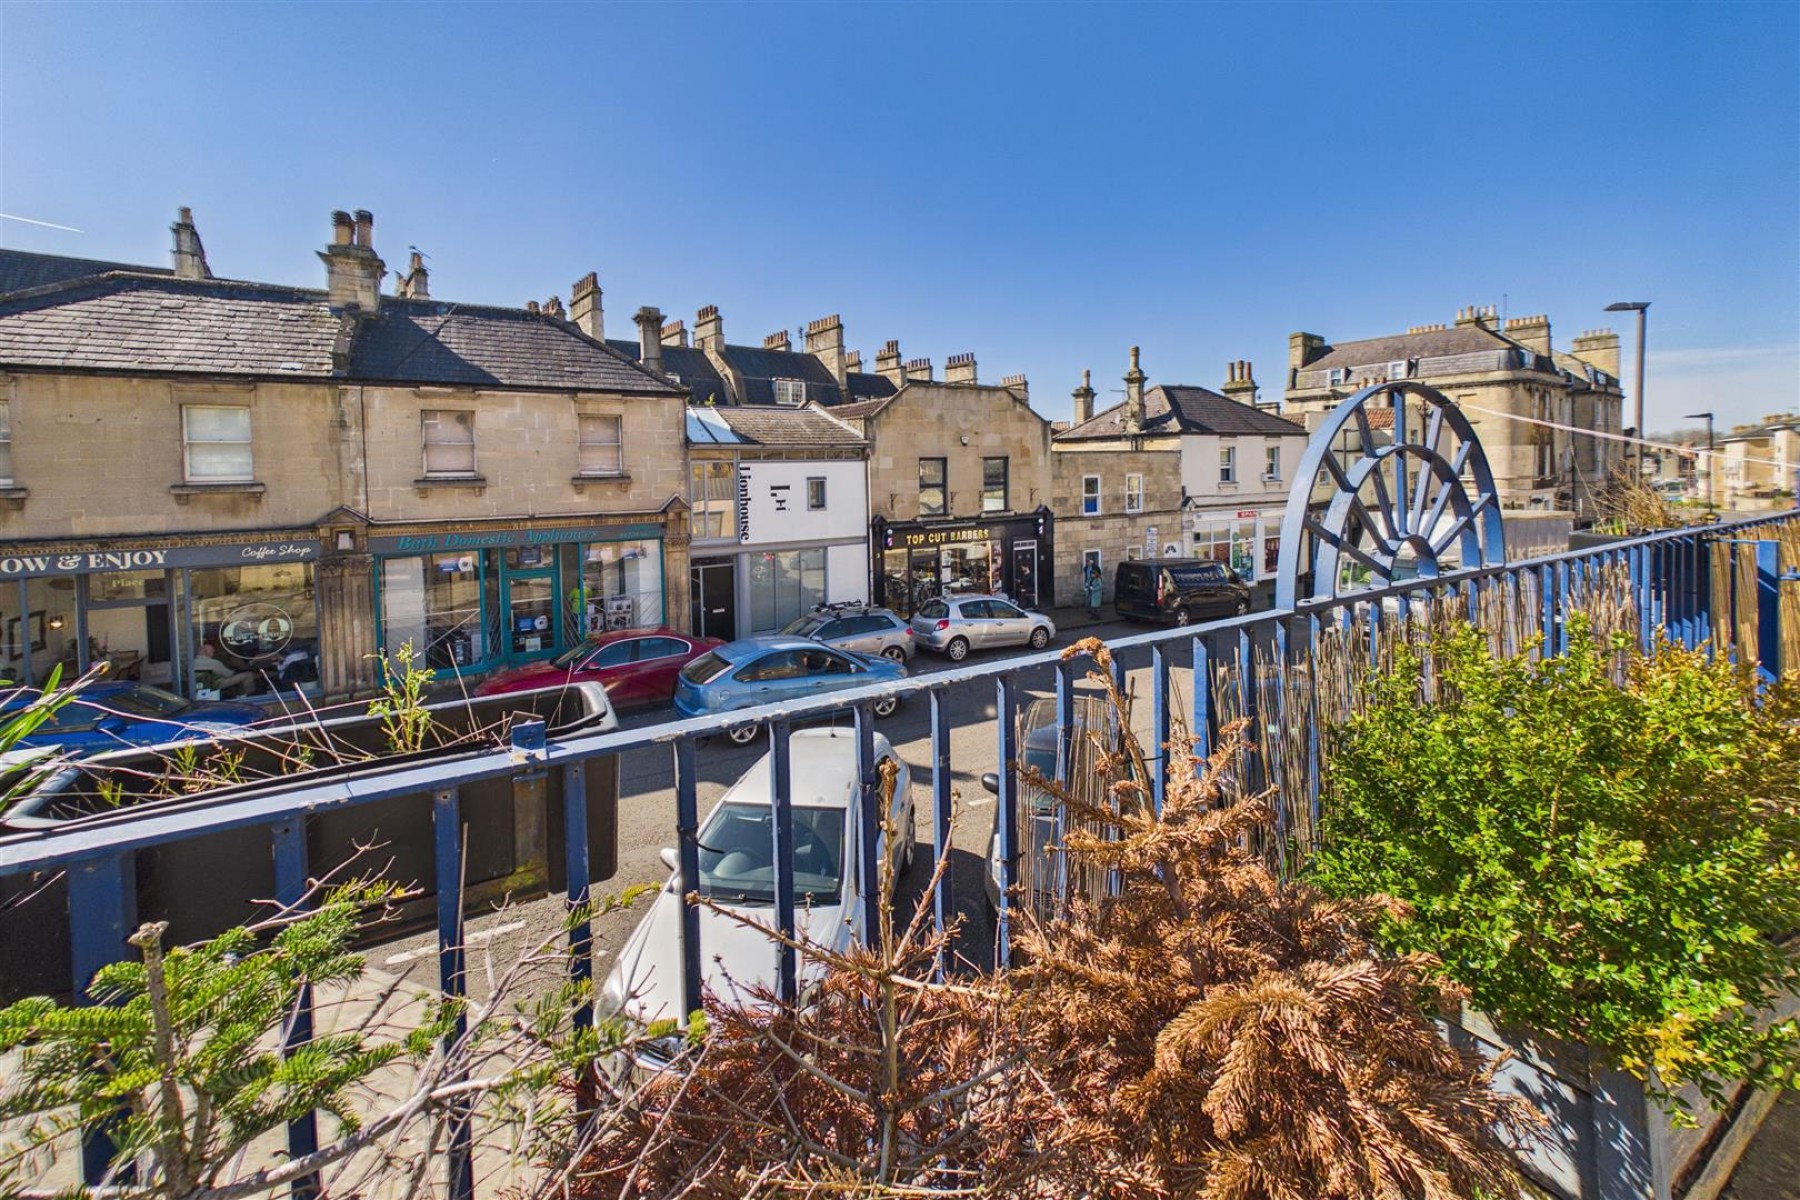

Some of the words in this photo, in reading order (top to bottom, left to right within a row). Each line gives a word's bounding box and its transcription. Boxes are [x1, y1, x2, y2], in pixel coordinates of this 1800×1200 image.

[740, 466, 752, 541] Lionhouse
[397, 534, 438, 550] Bath
[906, 533, 925, 545] TOP
[928, 532, 947, 543] CUT
[950, 529, 989, 541] BARBERS
[241, 547, 277, 559] Coffee
[279, 544, 312, 557] Shop
[58, 555, 82, 570] &
[88, 550, 168, 569] ENJOY
